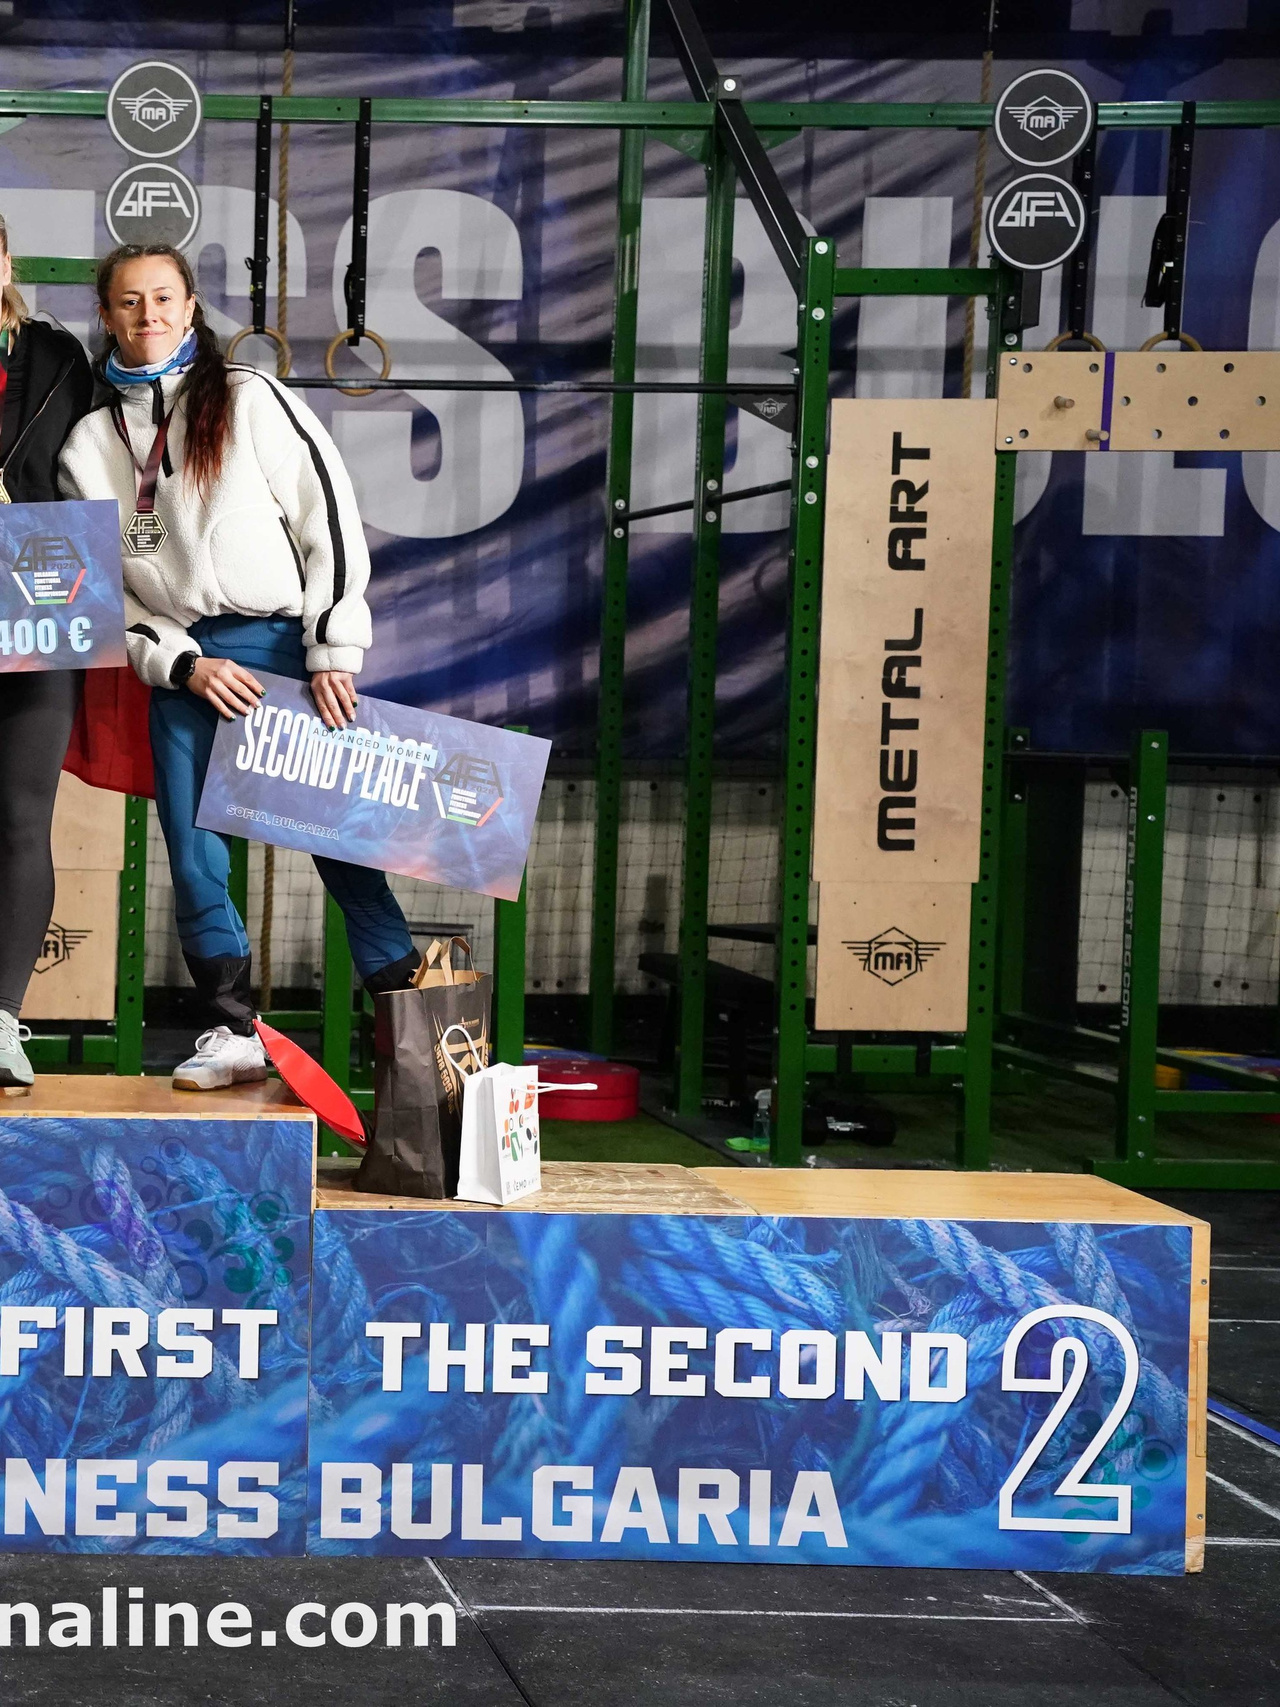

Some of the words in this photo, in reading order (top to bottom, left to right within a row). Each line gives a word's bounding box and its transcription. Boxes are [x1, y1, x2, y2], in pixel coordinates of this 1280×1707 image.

[887, 431, 932, 572] ART
[67, 615, 93, 653] €
[235, 705, 345, 791] SECOND
[342, 726, 434, 812] PLACE
[312, 727, 381, 750] ADVANCED
[386, 744, 432, 762] WOMEN
[876, 607, 924, 853] METAL
[225, 804, 272, 826] SOFIA,
[272, 814, 340, 841] BULGARIA
[873, 950, 914, 973] MA
[0, 1305, 280, 1379] FIRST
[365, 1321, 551, 1395] THE
[584, 1325, 968, 1402] SECOND
[998, 1304, 1141, 1535] 2
[320, 1460, 849, 1549] BULGARIA
